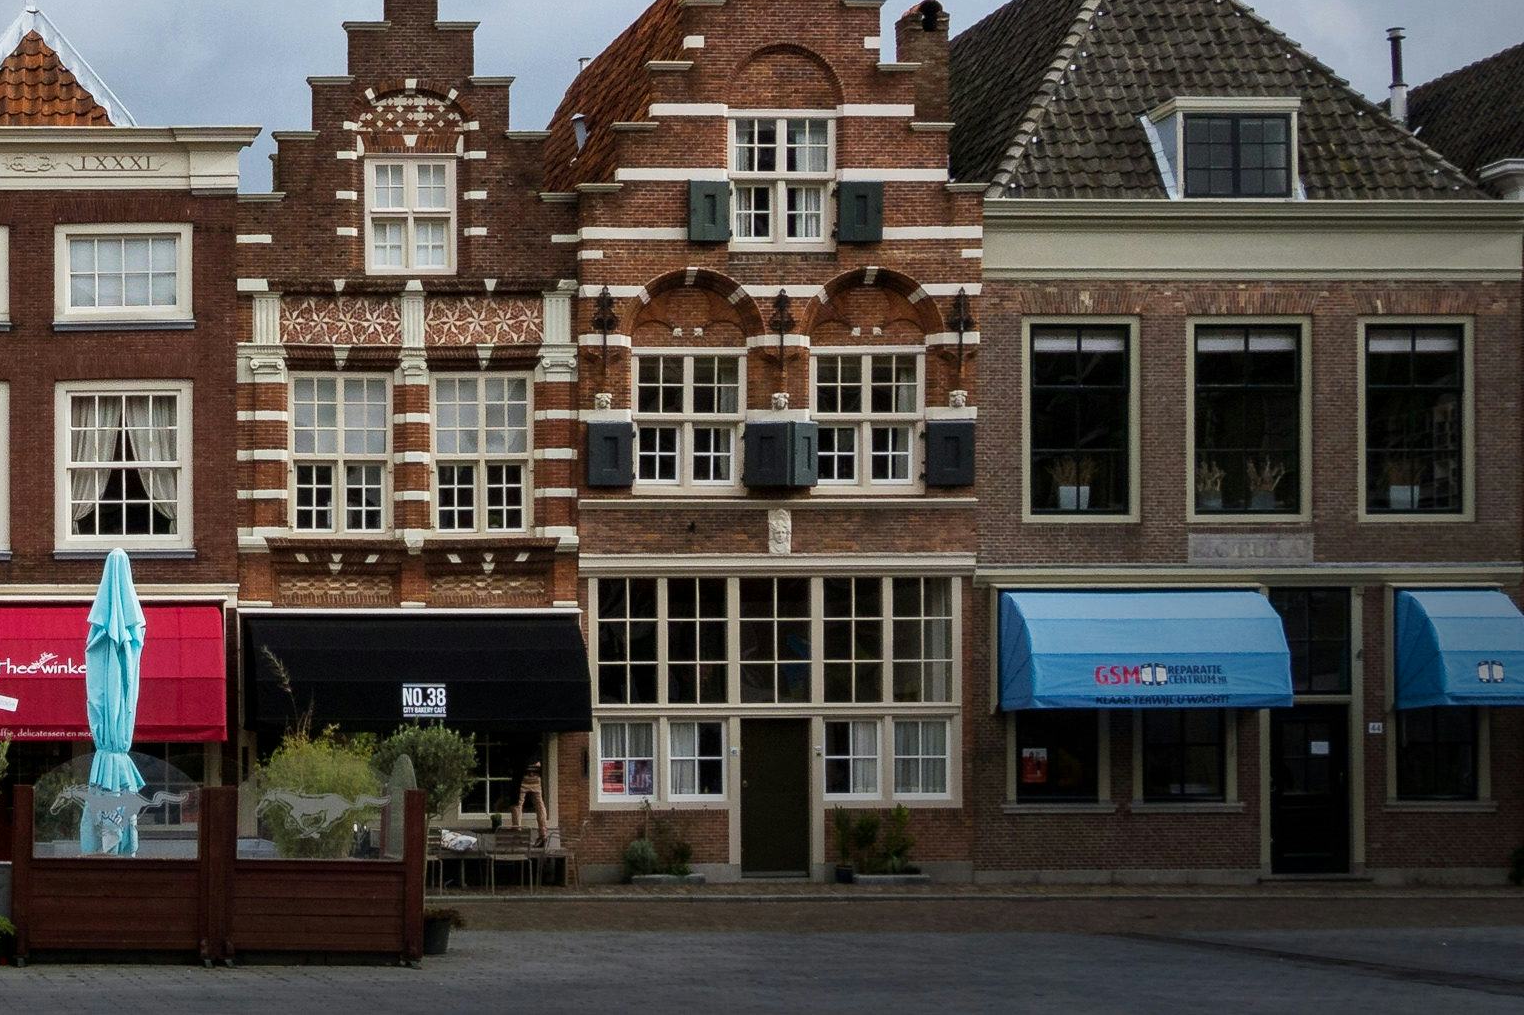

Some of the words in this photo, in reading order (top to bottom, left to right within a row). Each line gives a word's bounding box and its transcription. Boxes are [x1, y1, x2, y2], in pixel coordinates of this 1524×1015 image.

[1094, 665, 1141, 685] GSM
[1167, 664, 1223, 675] REPARATIE
[402, 687, 446, 706] NO.38
[1095, 696, 1132, 705] KLAAR
[1133, 695, 1175, 706] TERWIJL
[1177, 695, 1185, 705] U
[403, 706, 414, 714] CITY
[17, 728, 66, 738] delicatessen
